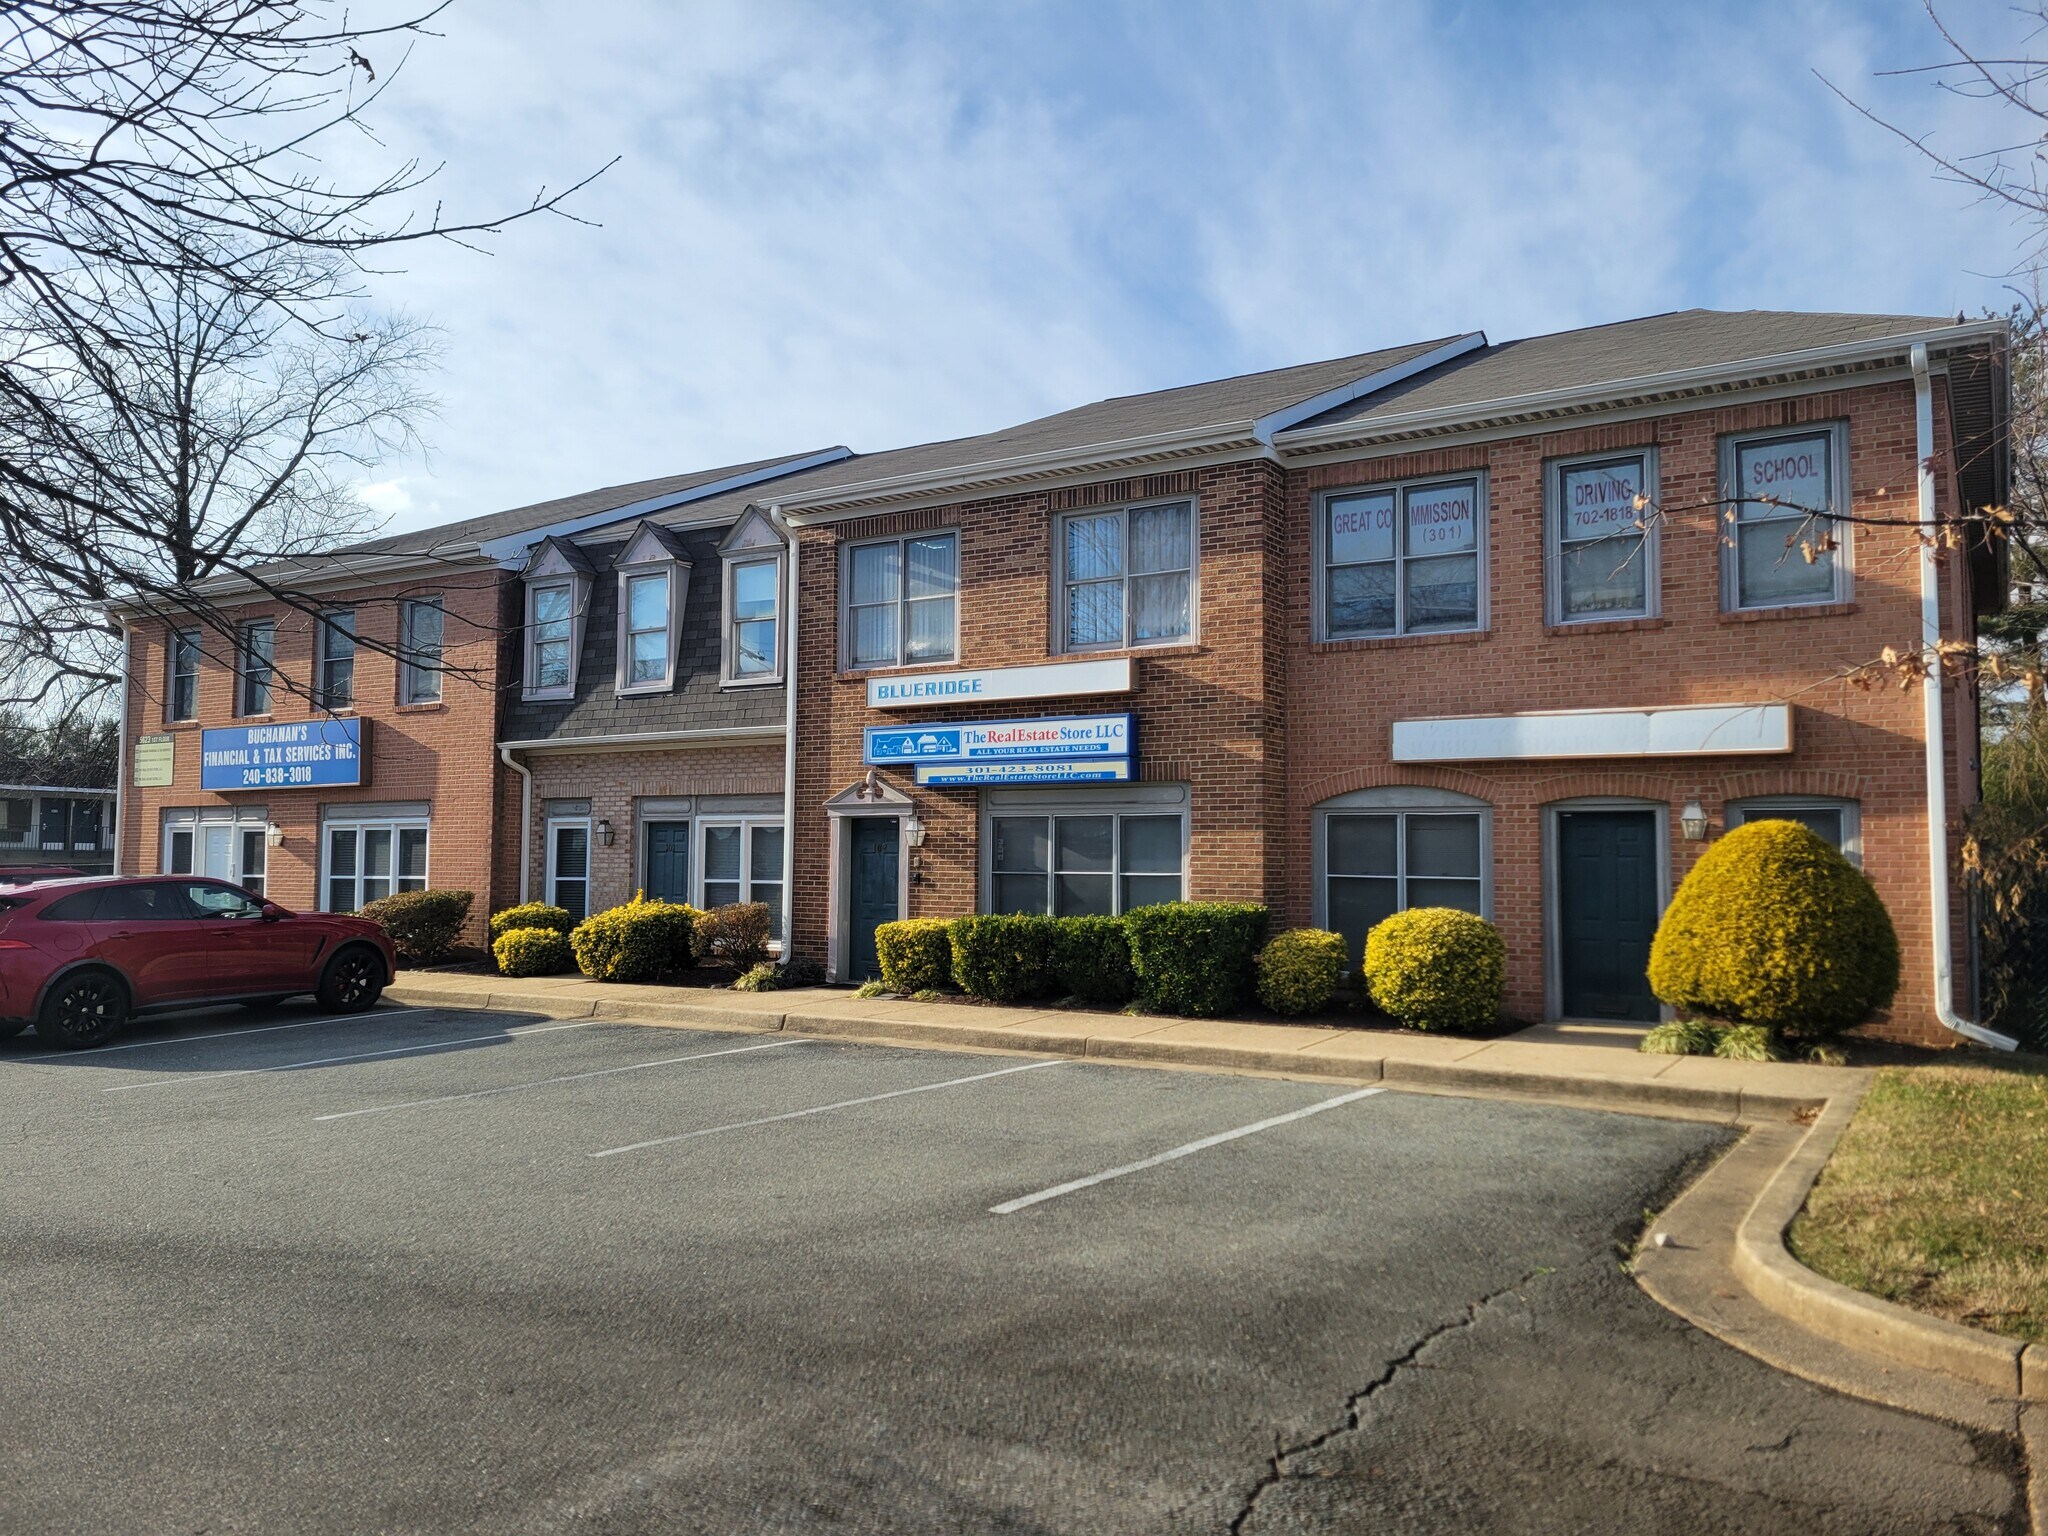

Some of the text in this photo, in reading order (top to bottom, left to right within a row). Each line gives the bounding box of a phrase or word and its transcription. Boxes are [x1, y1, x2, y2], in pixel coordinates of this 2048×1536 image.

[1754, 455, 1818, 485] SCHOOL
[1575, 479, 1631, 507] DRIVING
[1334, 499, 1469, 534] GREAT CO MMISSION
[1574, 506, 1633, 526] 702-1818
[877, 678, 982, 699] BLUERIDGE
[247, 725, 308, 745] BUCHANAN'S
[1096, 724, 1124, 738] LLC
[204, 742, 356, 767] FINANCIAL & TAX SERVICES INC.
[993, 747, 1015, 755] YOUR
[1040, 745, 1070, 753] ESTATE
[1071, 744, 1101, 752] NEEDS
[242, 766, 312, 785] 240-838-3018
[941, 772, 1102, 782] www.TheRealEstateStoreLLC.com
[965, 764, 1073, 774] 301-423-8081
